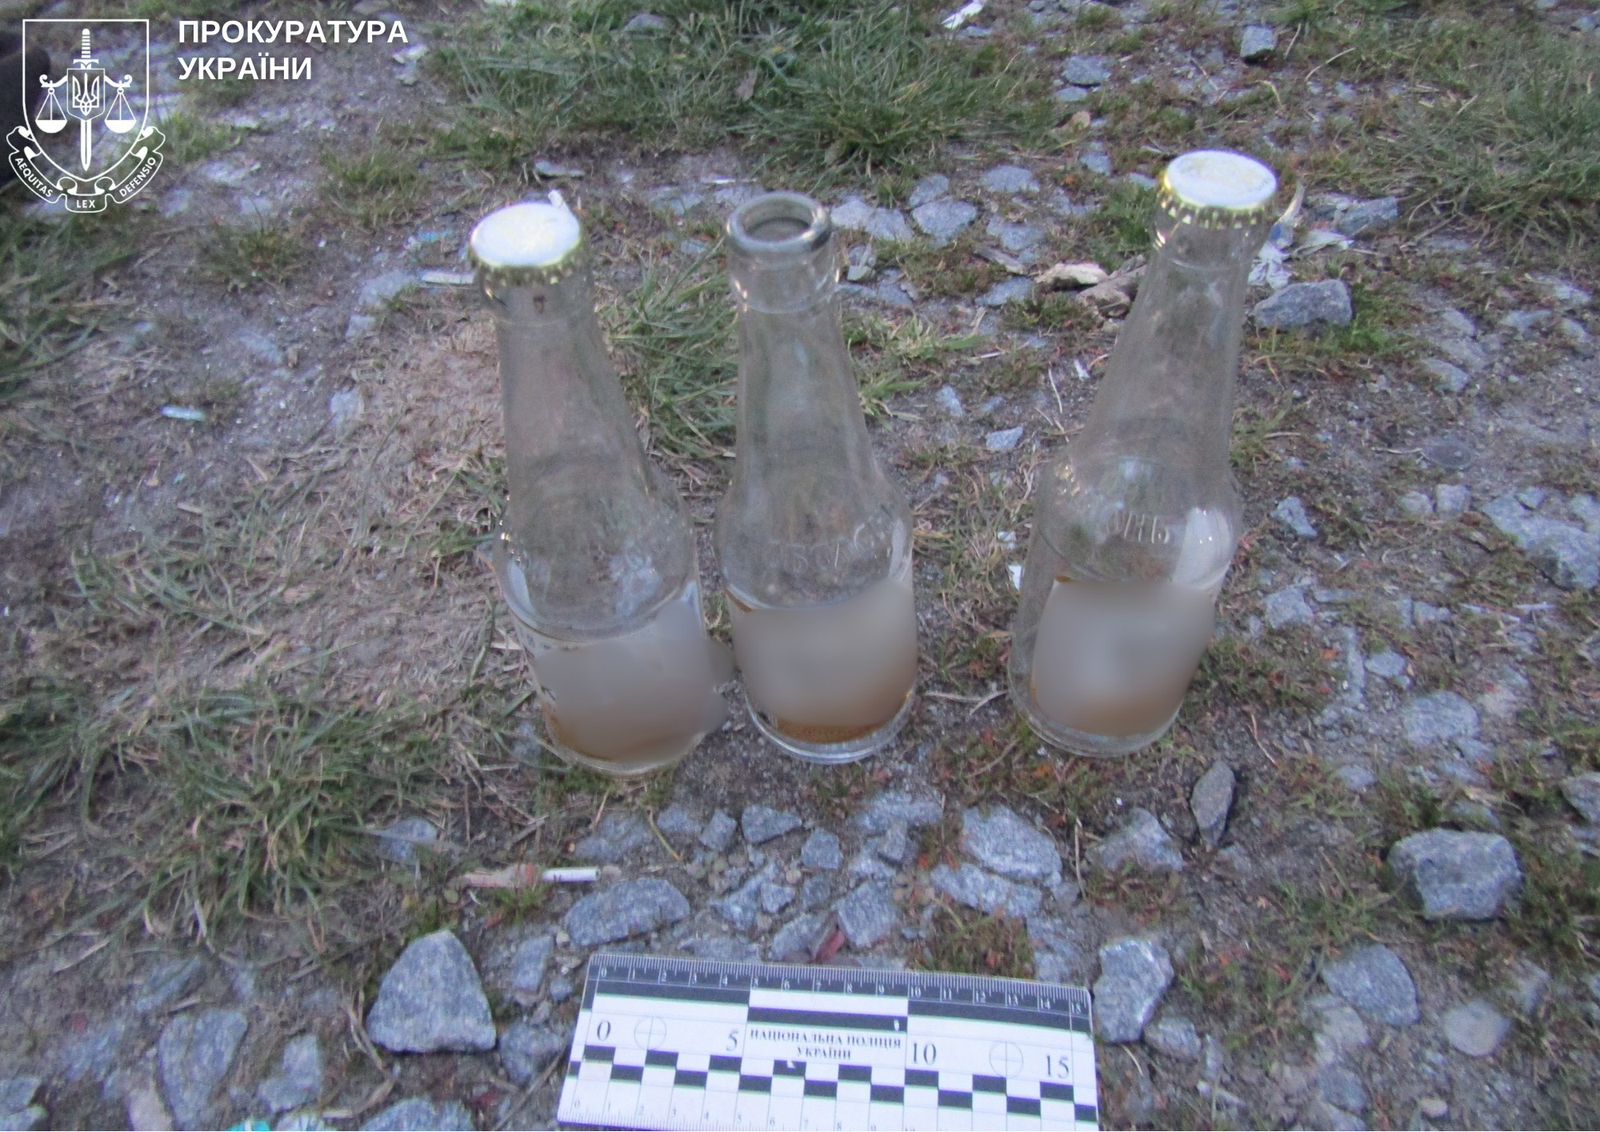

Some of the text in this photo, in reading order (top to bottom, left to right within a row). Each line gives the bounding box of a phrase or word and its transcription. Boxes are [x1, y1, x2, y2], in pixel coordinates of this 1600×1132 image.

[910, 986, 921, 998] 10
[943, 989, 952, 1001] 11
[975, 992, 986, 1004] 12
[1040, 998, 1050, 1010] 14
[596, 1019, 1070, 1079] 0 5 10 15
[750, 1029, 901, 1050] НАЦІОНАЛЬНА ПОЛІЦІЯ
[797, 1047, 851, 1059] УКРАЇНИ
